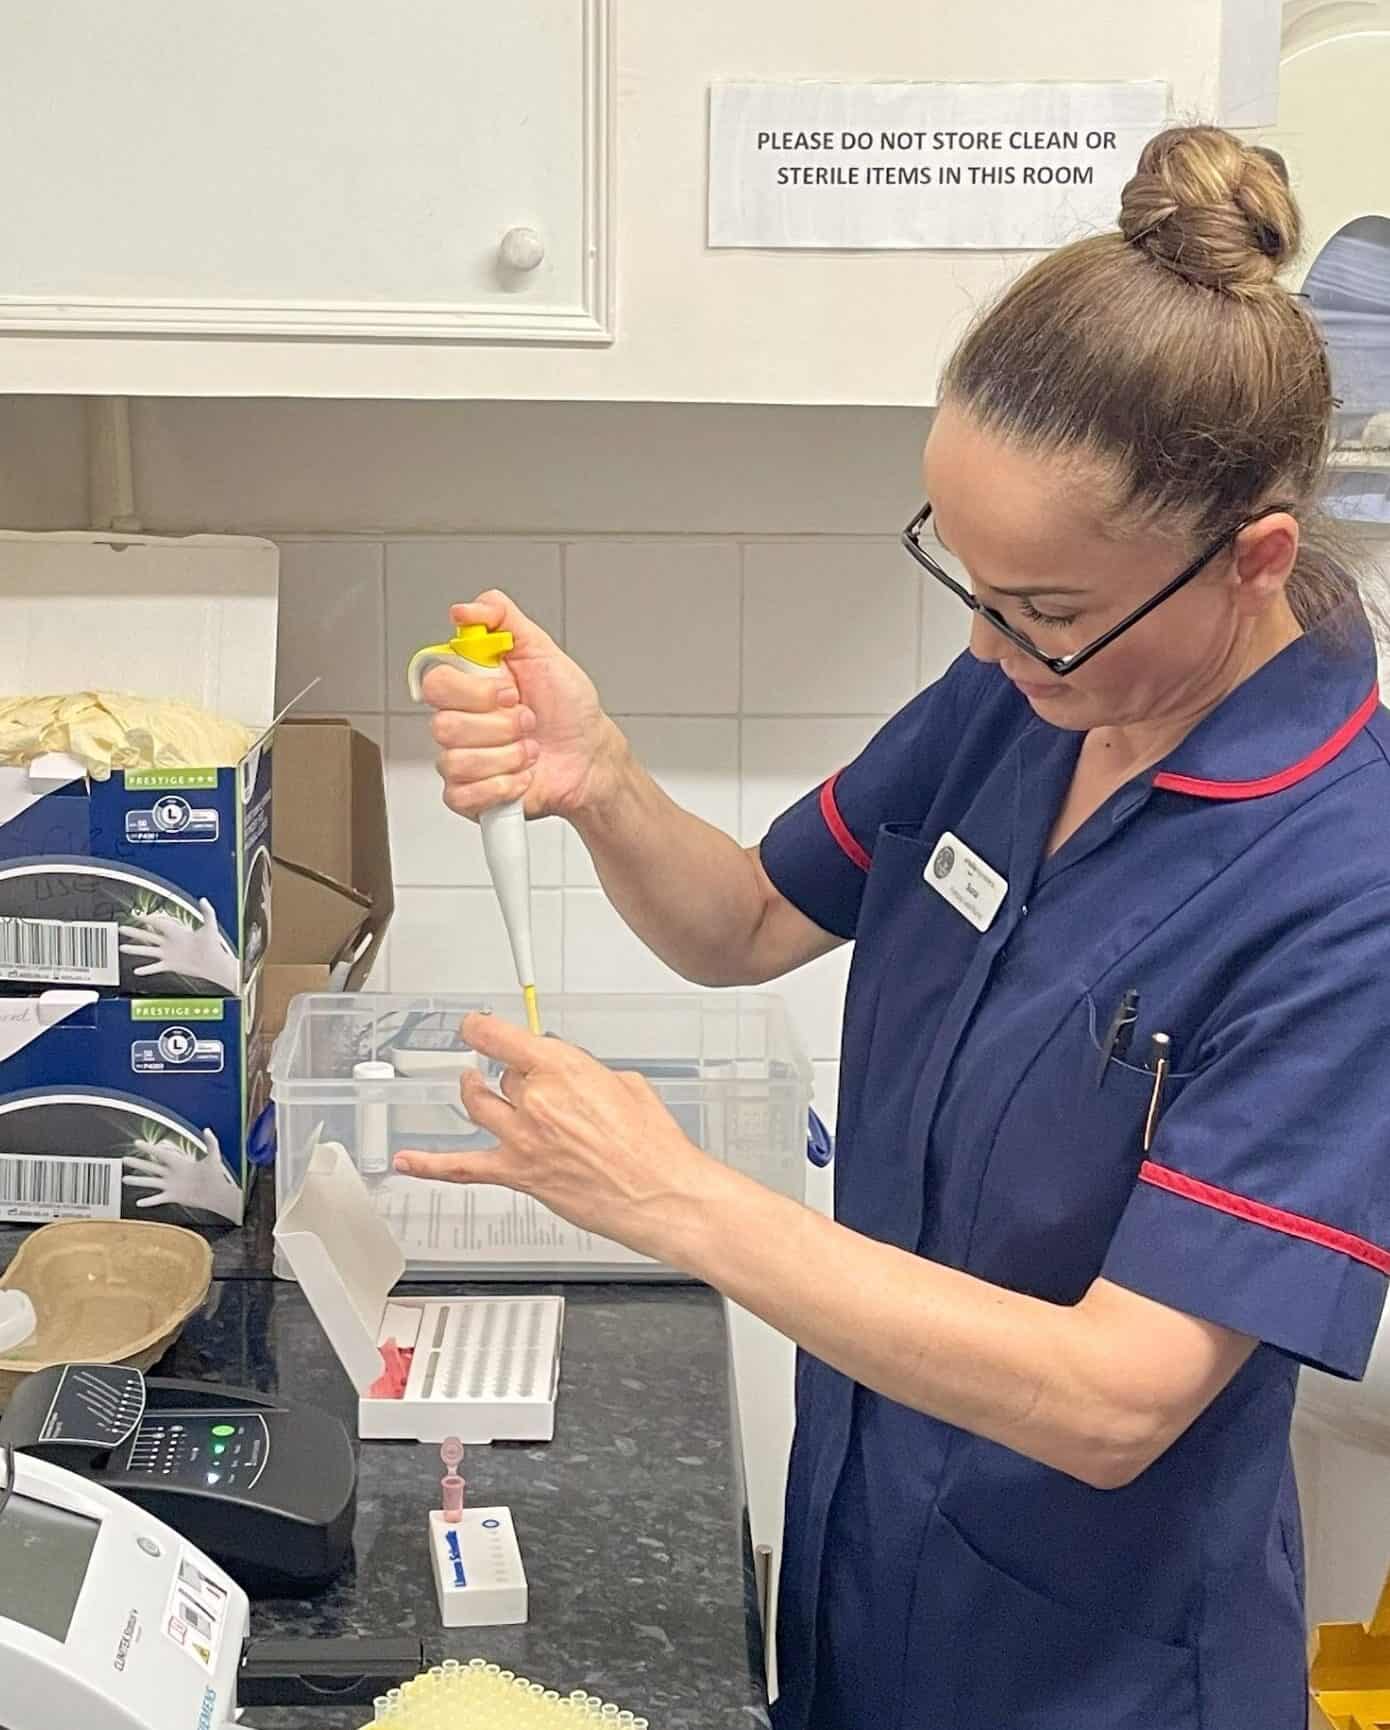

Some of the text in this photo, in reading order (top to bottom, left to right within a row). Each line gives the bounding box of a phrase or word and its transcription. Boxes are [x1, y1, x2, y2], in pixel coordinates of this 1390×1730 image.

[757, 131, 1117, 150] PLEASE DO NOT STORE CLEAN OR
[777, 166, 1094, 185] STERILE ITEMS IN THIS ROOM
[129, 776, 184, 785] PRESTIGE
[136, 1007, 191, 1015] PRESTIGE
